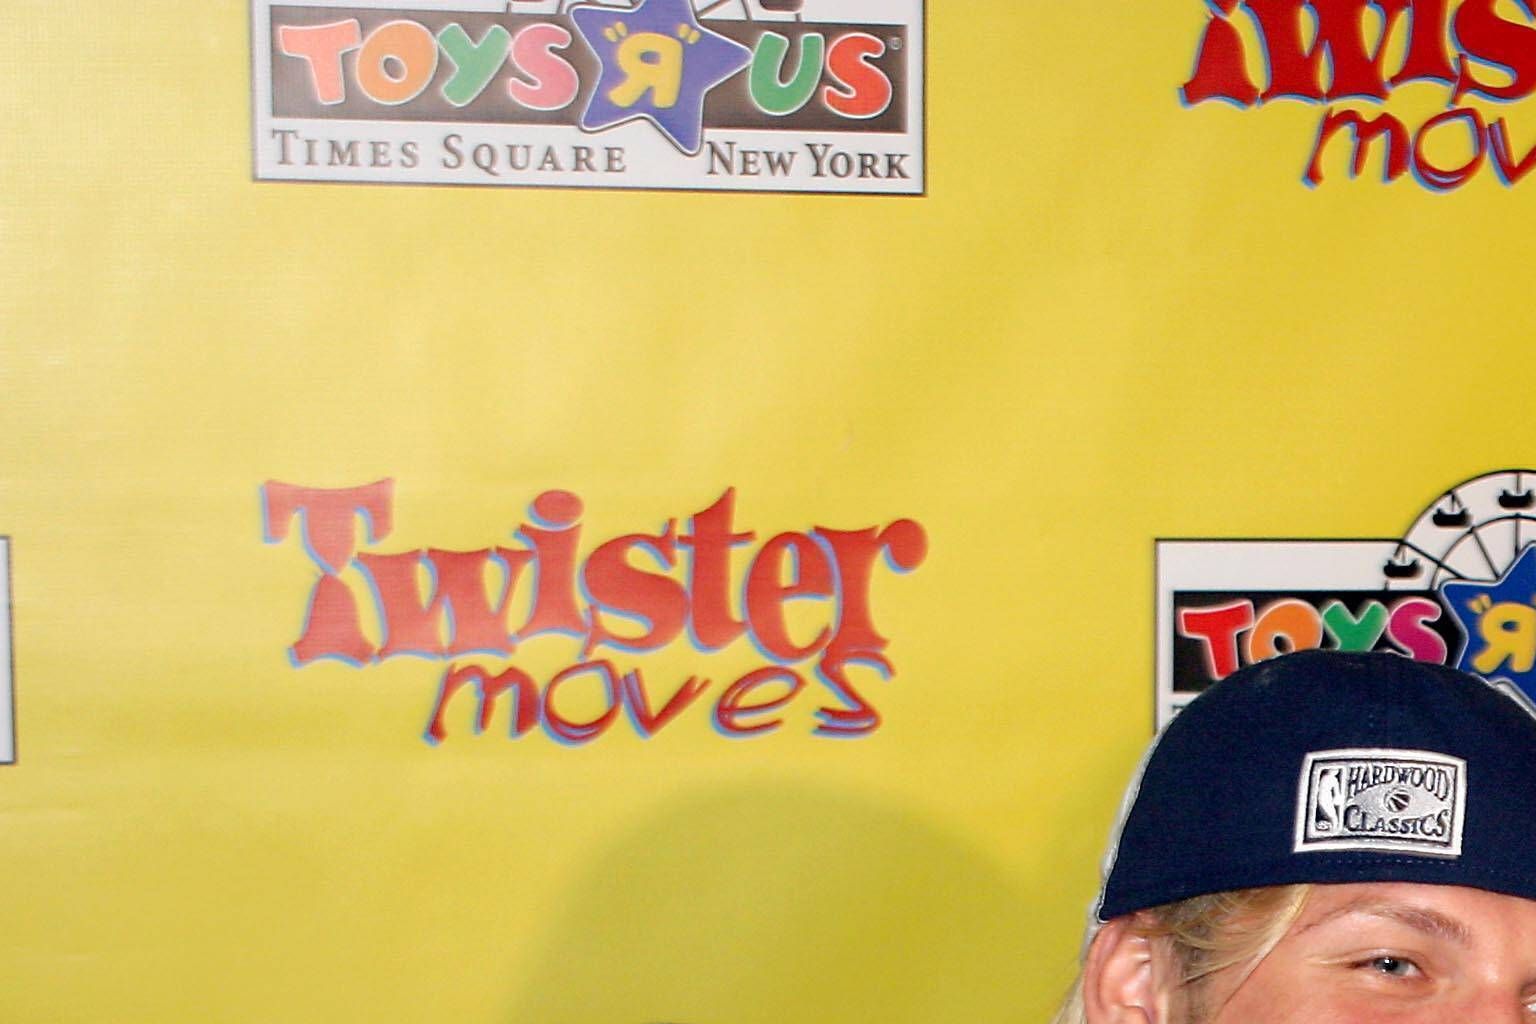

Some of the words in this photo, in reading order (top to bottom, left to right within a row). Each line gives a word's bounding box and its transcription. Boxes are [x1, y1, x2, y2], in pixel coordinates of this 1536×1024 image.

[279, 18, 581, 108] TOYS
[747, 30, 893, 119] US
[271, 127, 418, 170] TIMES
[442, 133, 627, 177] SQUARE
[706, 140, 797, 178] NEW
[808, 142, 911, 181] YORK
[260, 476, 929, 666] Twister
[421, 657, 897, 746] moves
[1349, 764, 1450, 801] HARDWOOD
[1344, 804, 1450, 837] CLASSICS
